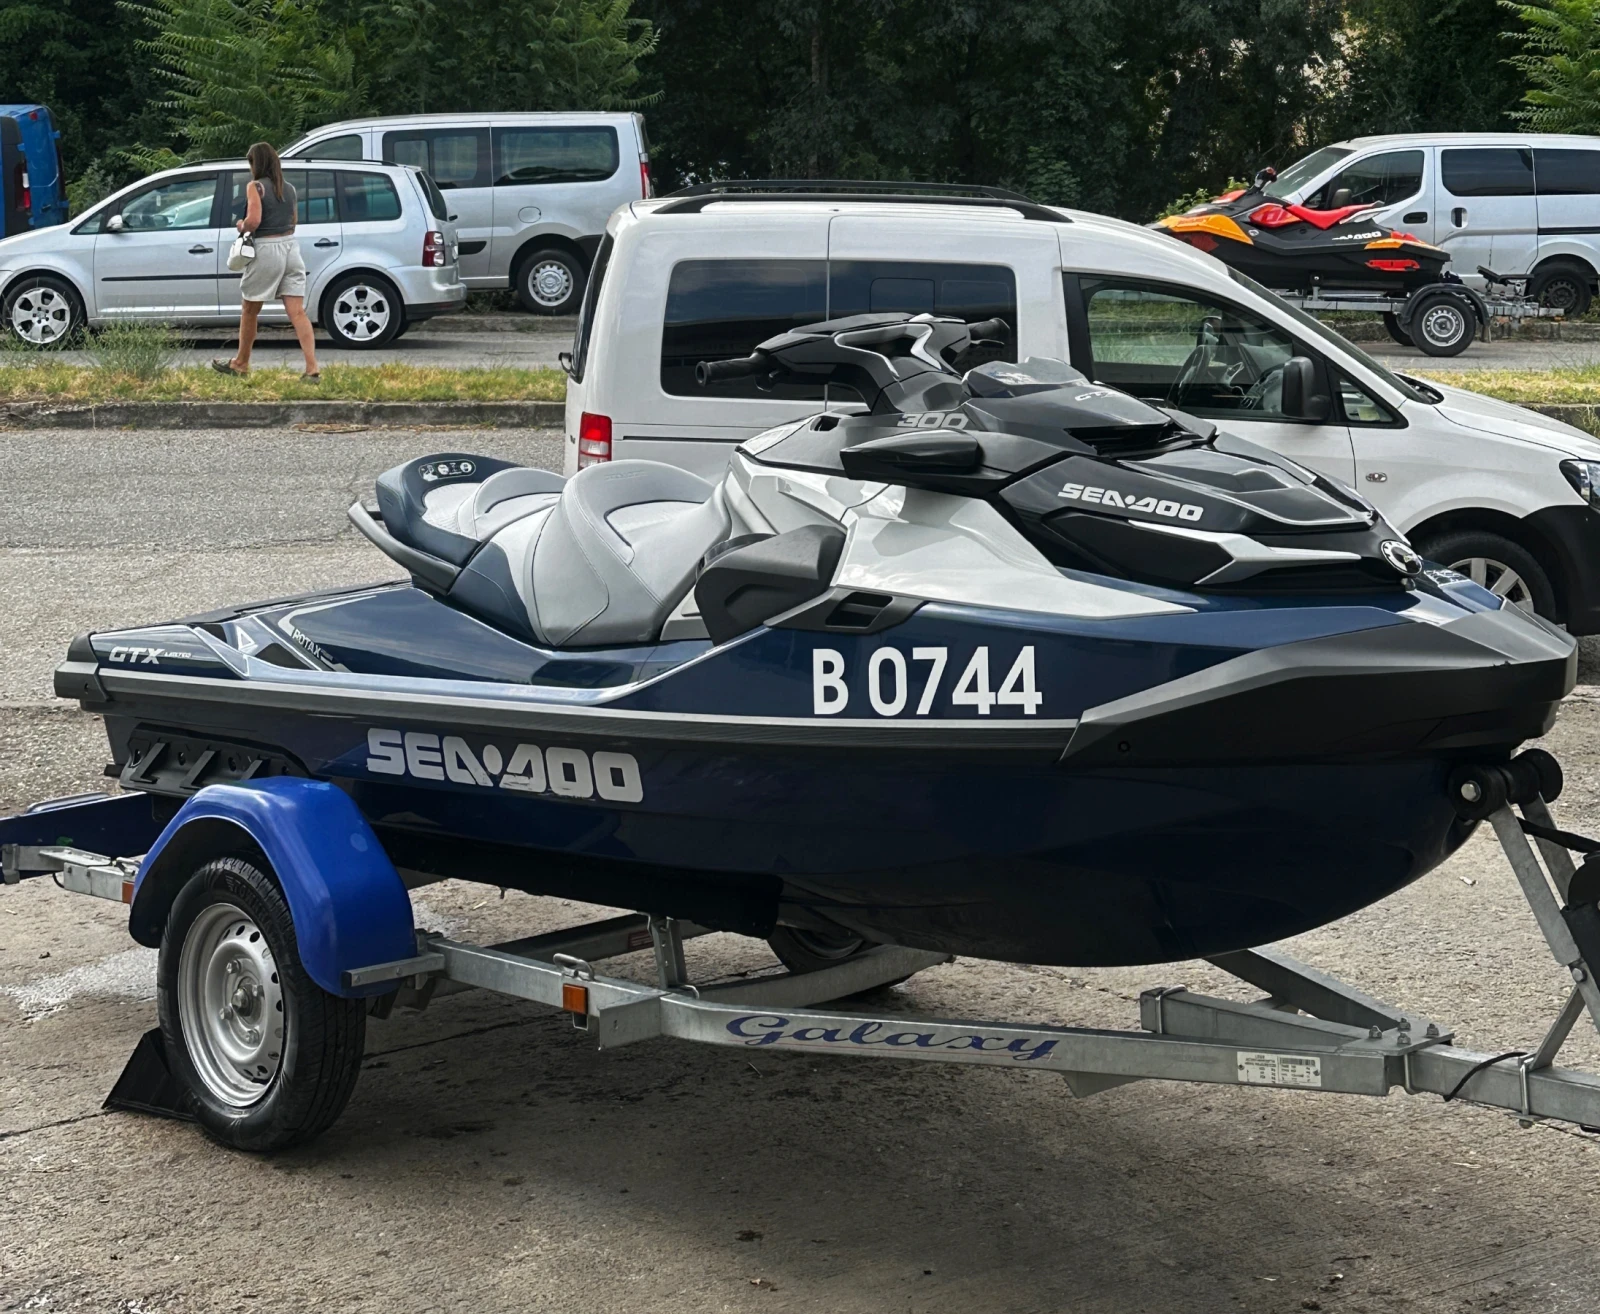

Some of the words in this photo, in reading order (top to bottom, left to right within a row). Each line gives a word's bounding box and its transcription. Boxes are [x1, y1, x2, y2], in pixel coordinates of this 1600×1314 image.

[897, 413, 969, 430] 300
[109, 646, 165, 665] GTX
[292, 628, 322, 659] ROTAX
[812, 647, 850, 716] B
[868, 645, 1044, 717] 0744
[725, 1015, 1060, 1061] Galaxy
